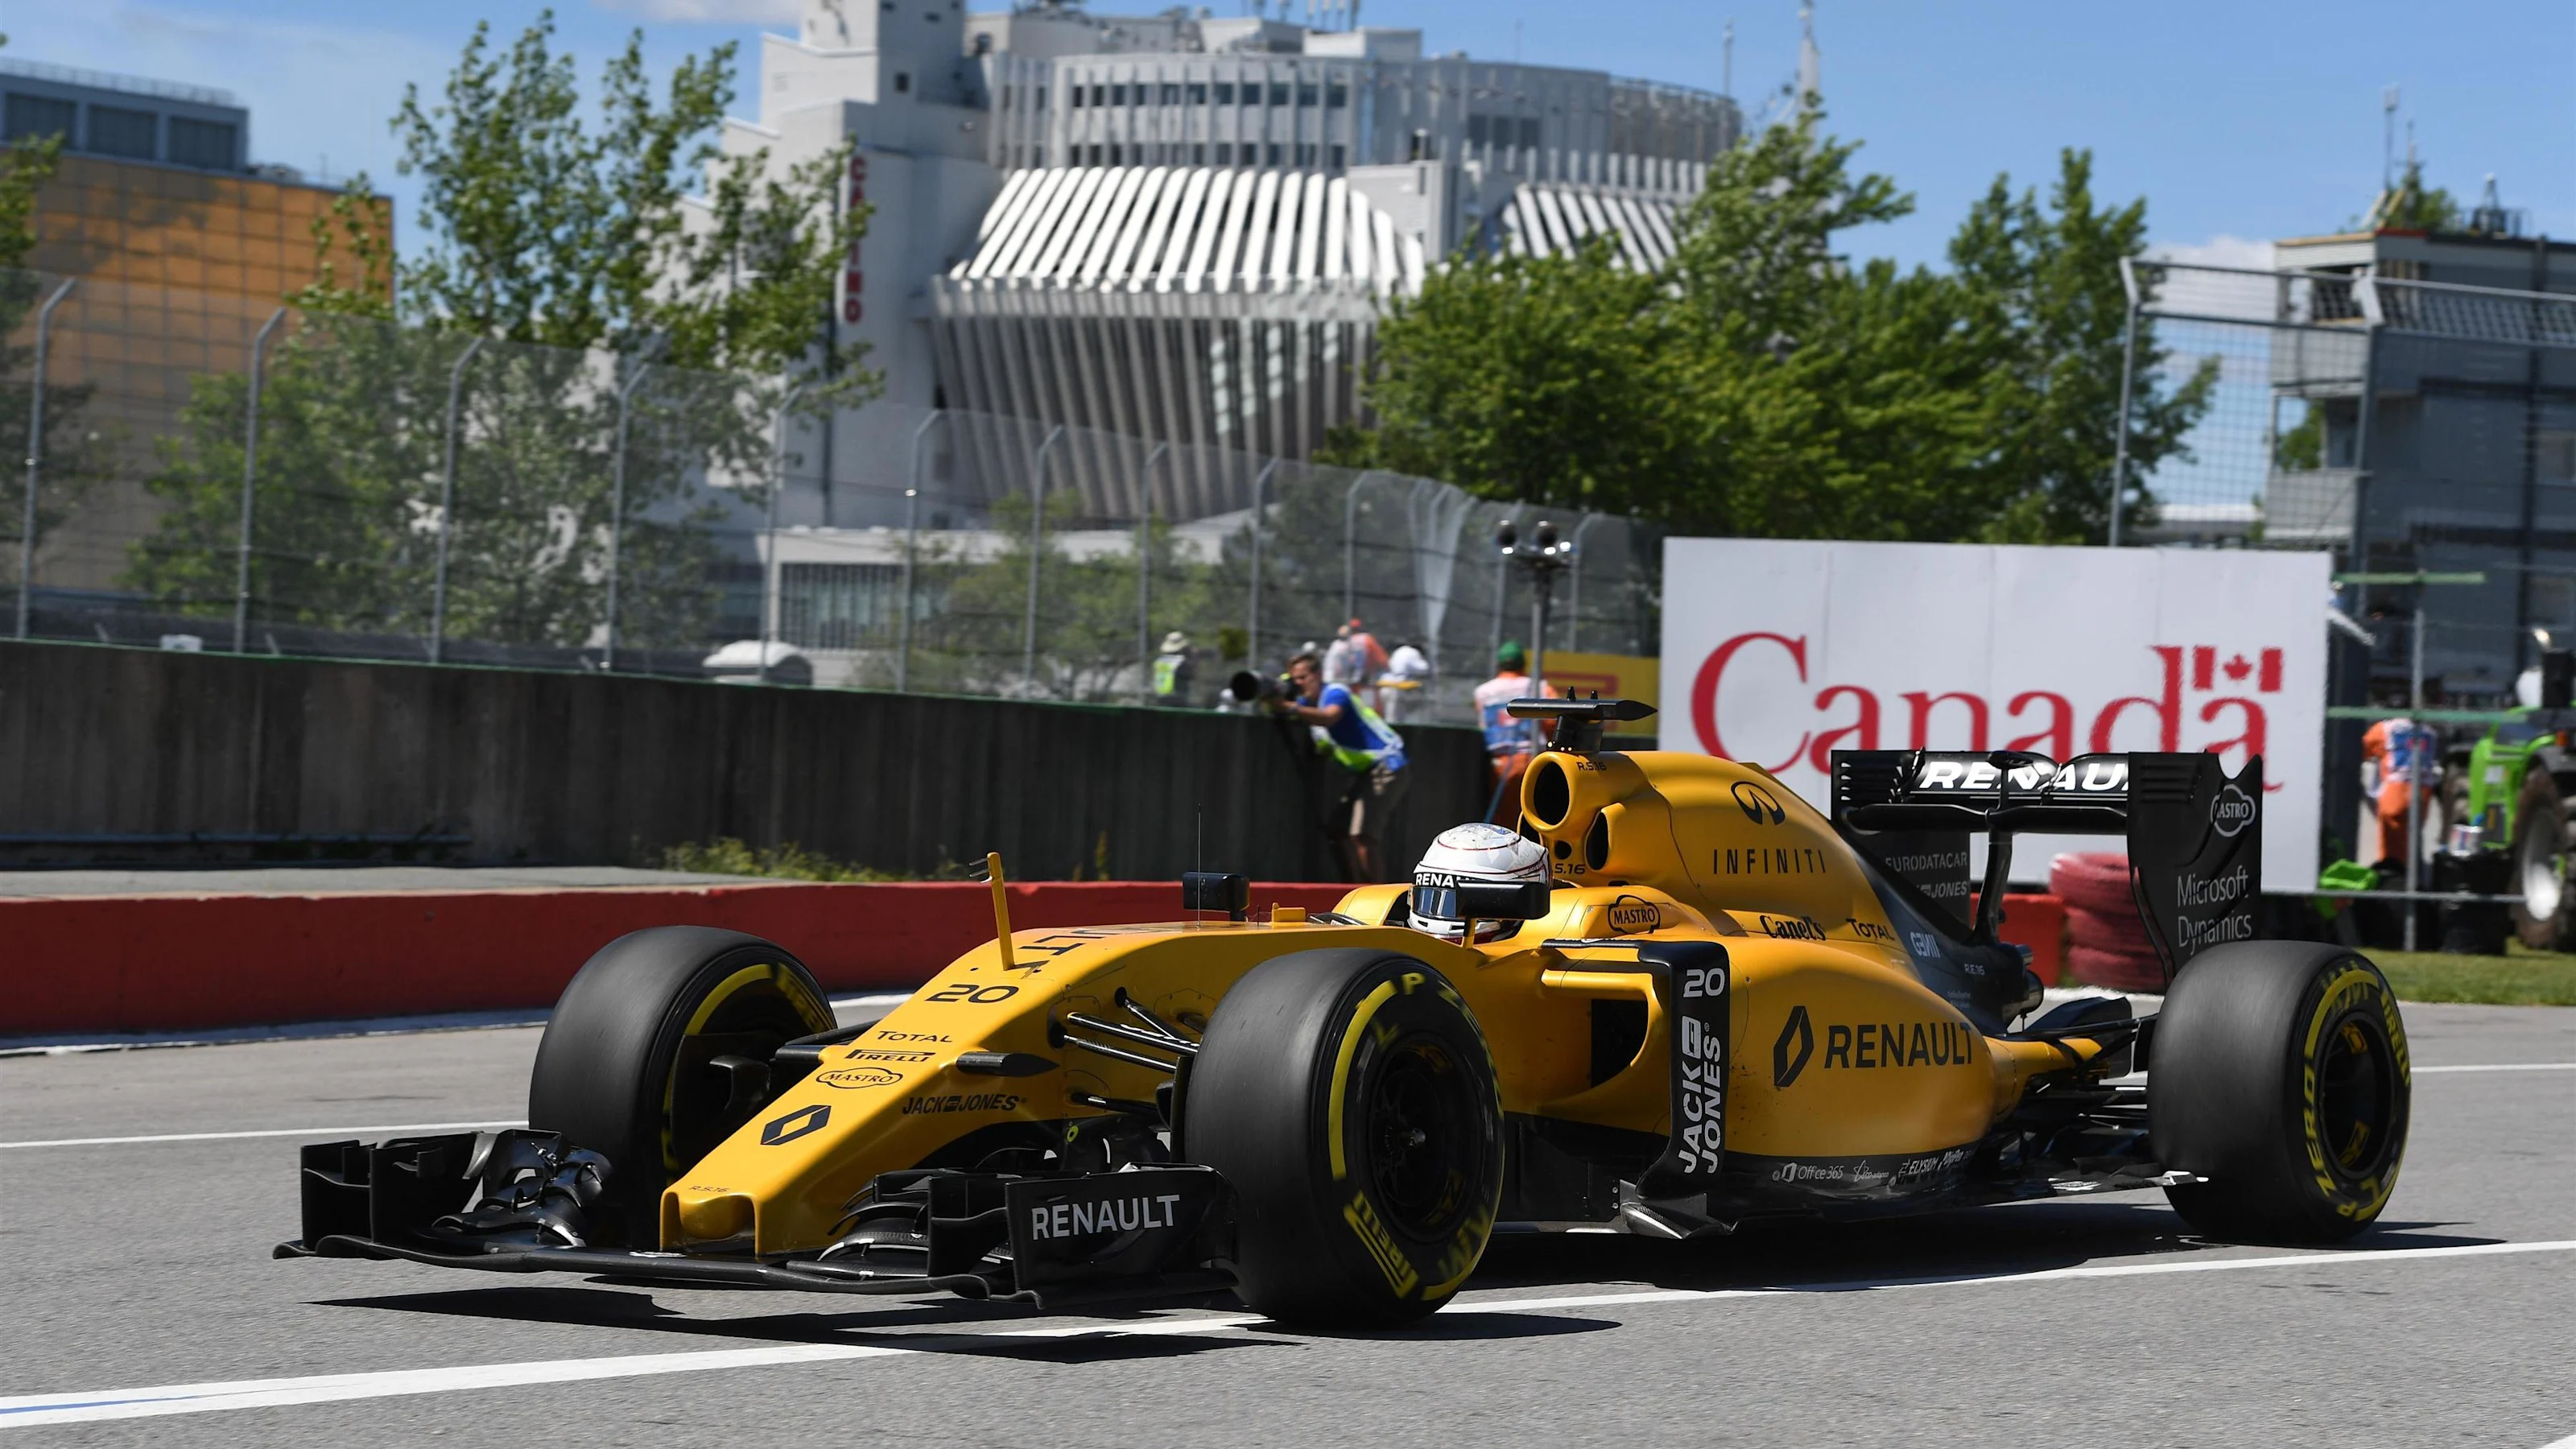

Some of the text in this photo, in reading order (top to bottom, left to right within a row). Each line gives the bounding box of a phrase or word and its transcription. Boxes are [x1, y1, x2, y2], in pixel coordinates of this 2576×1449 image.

[845, 156, 868, 324] CAINO
[1690, 631, 2283, 792] Canada
[1919, 761, 2129, 791] RENAU
[1713, 848, 1827, 874] INFINITI
[2177, 865, 2249, 907] Microsoft
[1614, 907, 1655, 925] MASTRO
[2178, 910, 2252, 956] Dynamics
[924, 984, 1019, 1004] 20
[1683, 968, 1725, 997] 20
[877, 1030, 953, 1042] TOTAL
[1824, 1022, 1972, 1069] RENAULT
[844, 1049, 936, 1063] PIRELLI
[824, 1072, 894, 1084] MASTRO
[1826, 1165, 1844, 1179] 365
[1031, 1195, 1180, 1241] RENAULT
